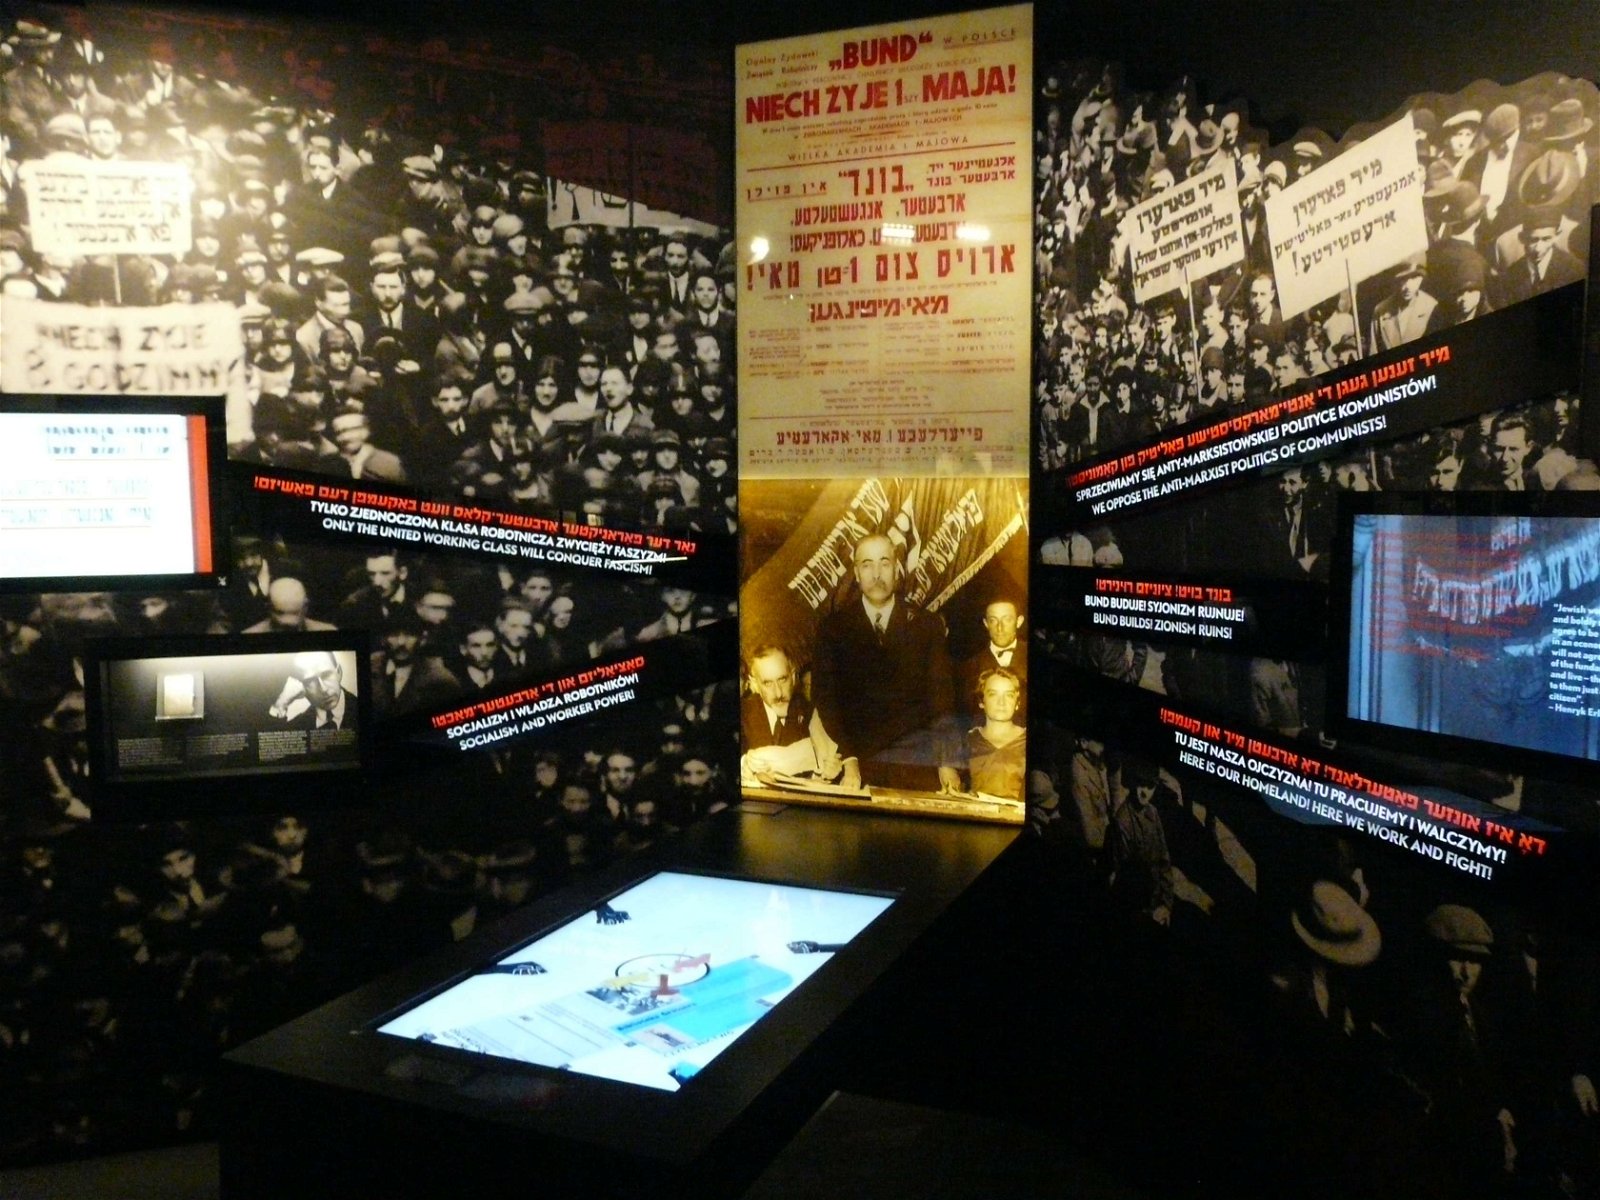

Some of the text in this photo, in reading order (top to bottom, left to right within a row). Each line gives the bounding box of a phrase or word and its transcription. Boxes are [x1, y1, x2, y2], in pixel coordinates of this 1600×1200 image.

[746, 89, 820, 124] NIECH
[923, 64, 1016, 103] MAJA!
[1350, 158, 1383, 185] מיר
[1199, 173, 1225, 198] מיר
[1419, 346, 1451, 369] מיר
[1372, 358, 1415, 388] זענען
[1317, 386, 1333, 400] די
[1076, 471, 1141, 502] SPRZECIWIAMY
[1281, 407, 1337, 437] POLITYCE
[1338, 374, 1437, 419] KOMUNISTÓW!
[1092, 415, 1387, 516] WE OPPOSE THE ANTI-MARXIST POLITICS OF COMMUNISTS!
[318, 486, 349, 500] דעם
[310, 501, 349, 517] TYLKO
[349, 506, 440, 530] ZJEDNOCZONA
[441, 520, 479, 536] KLASA
[480, 526, 555, 547] ROBOTNICZA
[556, 536, 613, 556] ZWYCIĘŻY
[322, 517, 653, 576] ONLY THE UNITED WORKING CLASS WILL CONQUER FASCISM!
[646, 536, 671, 549] דער
[1205, 588, 1232, 602] בונד
[1085, 595, 1245, 622] BUND BUDUJE! SYJONIZM RUJNUJE!
[1093, 612, 1233, 640] BUND BUILDS! ZIONISM RUINS!
[1553, 615, 1569, 624] and
[1552, 637, 1560, 645] in
[1578, 628, 1587, 637] to
[1588, 629, 1599, 638] be
[1550, 659, 1560, 668] of
[1560, 660, 1574, 669] the
[1551, 648, 1582, 659] will not
[541, 676, 576, 693] און די
[1549, 681, 1559, 690] to
[1559, 681, 1581, 692] them
[1550, 671, 1583, 682] and live
[446, 712, 509, 739] SOCJALIZM
[563, 673, 640, 705] ROBOTNIKÓW!
[1555, 703, 1587, 717] Henryk
[459, 689, 635, 751] SOCIALISM AND WORKER POWER!
[1203, 723, 1221, 740] און
[1224, 730, 1246, 749] מיר
[1175, 731, 1188, 744] TU
[1188, 737, 1209, 753] JEST
[1210, 744, 1246, 769] NASZA
[1248, 758, 1312, 792] OJCZYZNA!
[1314, 782, 1329, 798] TU
[1331, 790, 1409, 827] PRACUJEMY
[1417, 819, 1507, 865] WALCZYMY!
[1180, 751, 1493, 880] HERE IS OUR HOMELAND! HERE WE WORK AND FIGHT!
